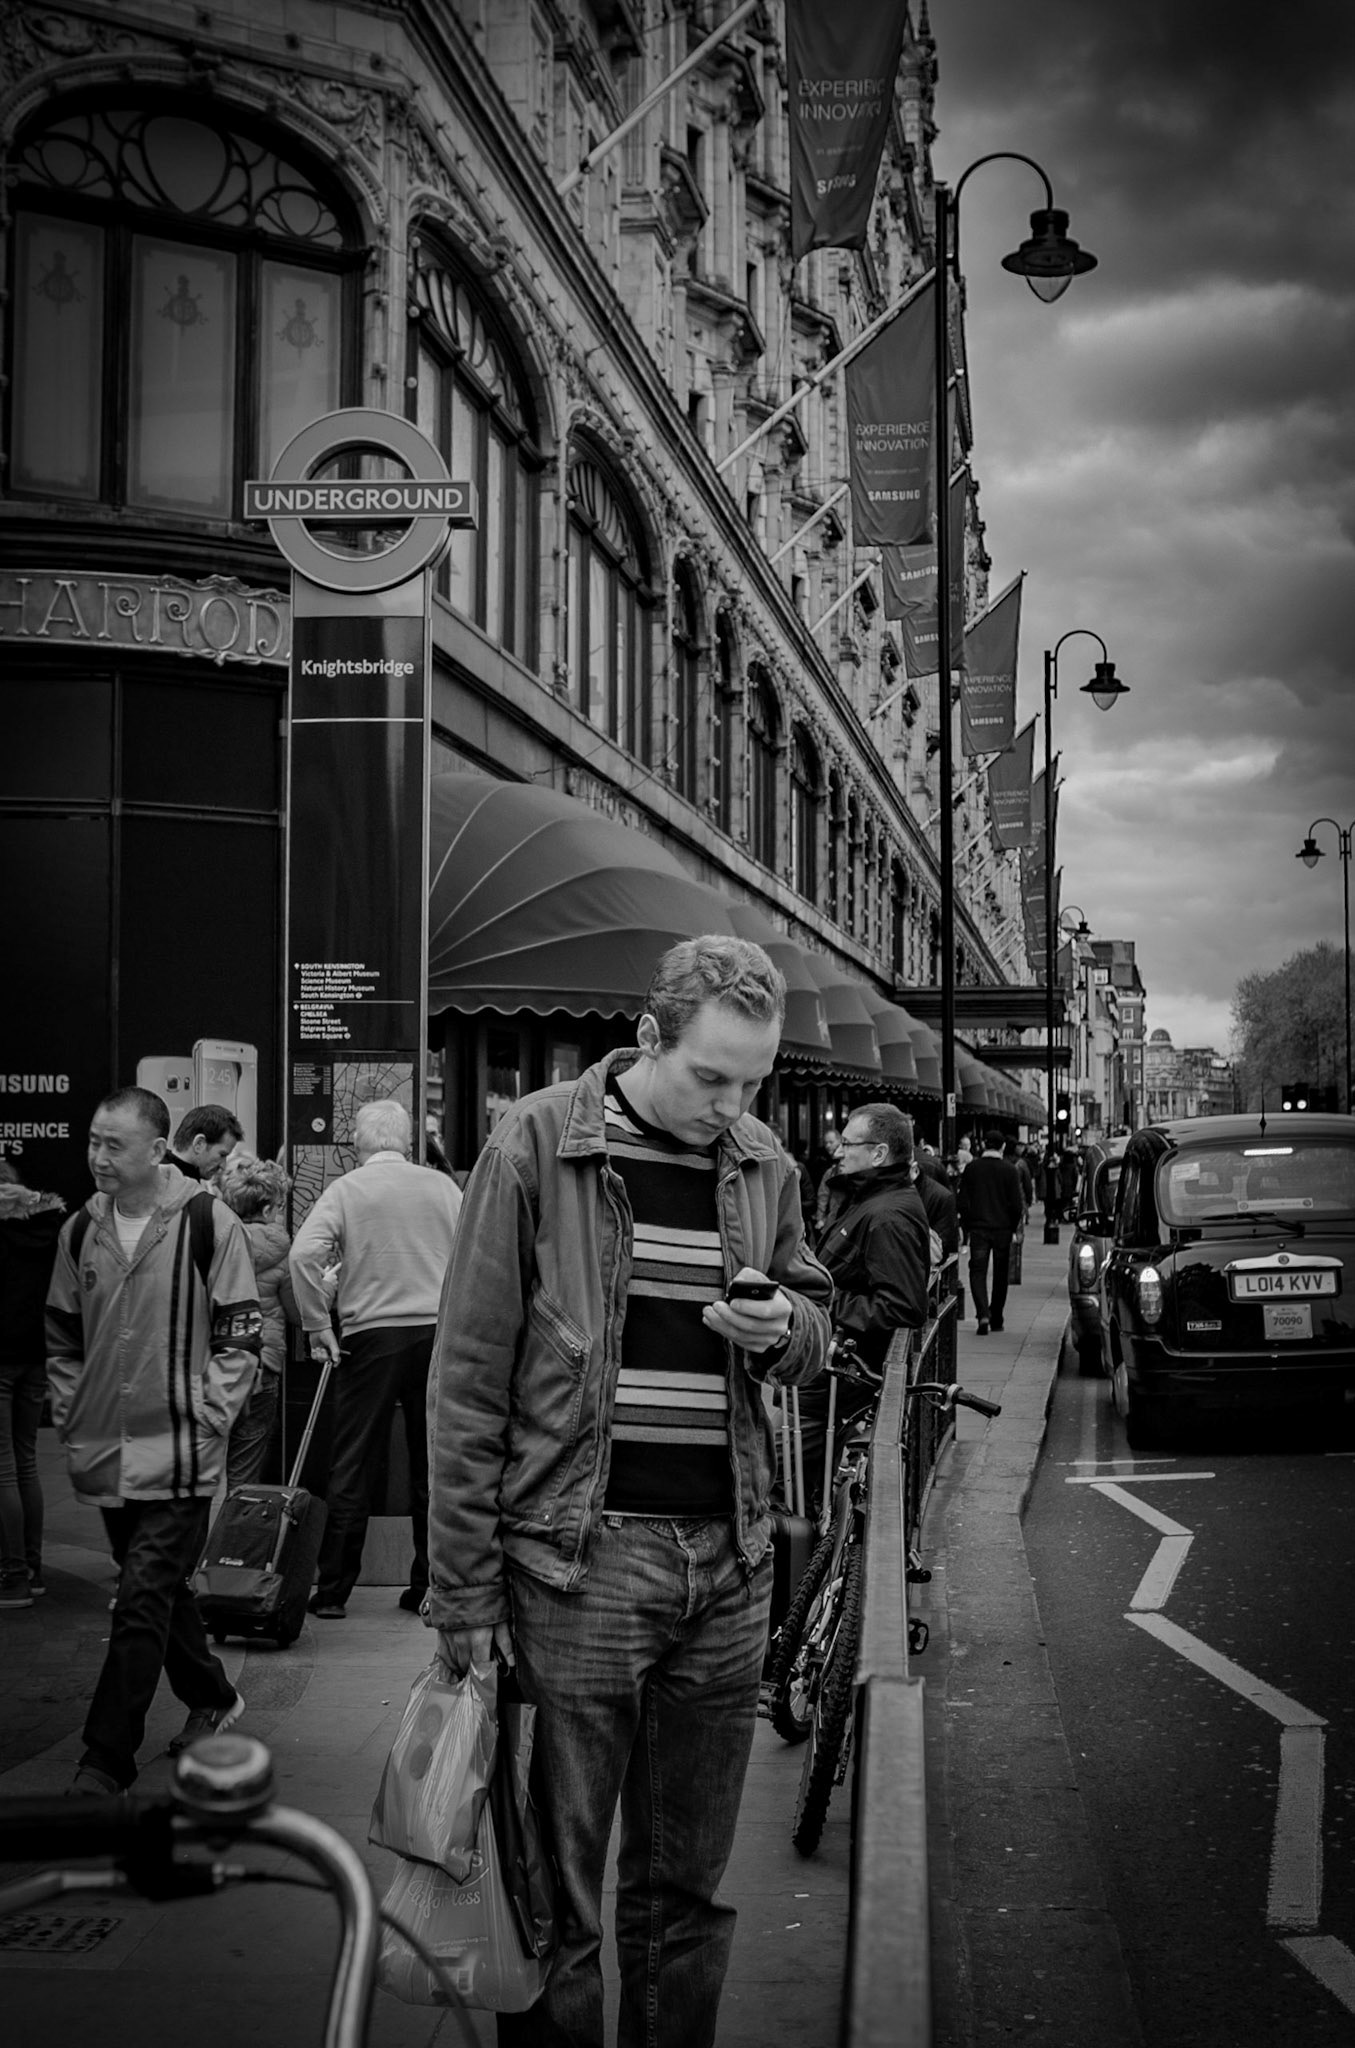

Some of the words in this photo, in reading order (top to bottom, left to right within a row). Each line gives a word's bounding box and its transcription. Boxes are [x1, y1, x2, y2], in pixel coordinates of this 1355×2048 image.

[855, 420, 930, 436] EXPERIENCE
[857, 437, 929, 452] INNOVATION
[253, 488, 463, 511] UNDERGROUND
[868, 489, 920, 501] SAMSUNG
[901, 566, 938, 580] SAMSUN
[0, 578, 289, 658] HARROD
[301, 659, 414, 678] Knightsbridge
[301, 963, 322, 971] SOUTH
[323, 963, 365, 971] KENSINGTON
[324, 985, 348, 993] History
[320, 992, 354, 1000] Kensington
[300, 1025, 326, 1033] Belgrave
[327, 1025, 348, 1033] Square
[300, 1032, 321, 1040] Sloane
[322, 1032, 343, 1040] Square
[1246, 1276, 1284, 1293] LO14
[1289, 1274, 1323, 1291] KVV
[1273, 1316, 1303, 1326] 70090
